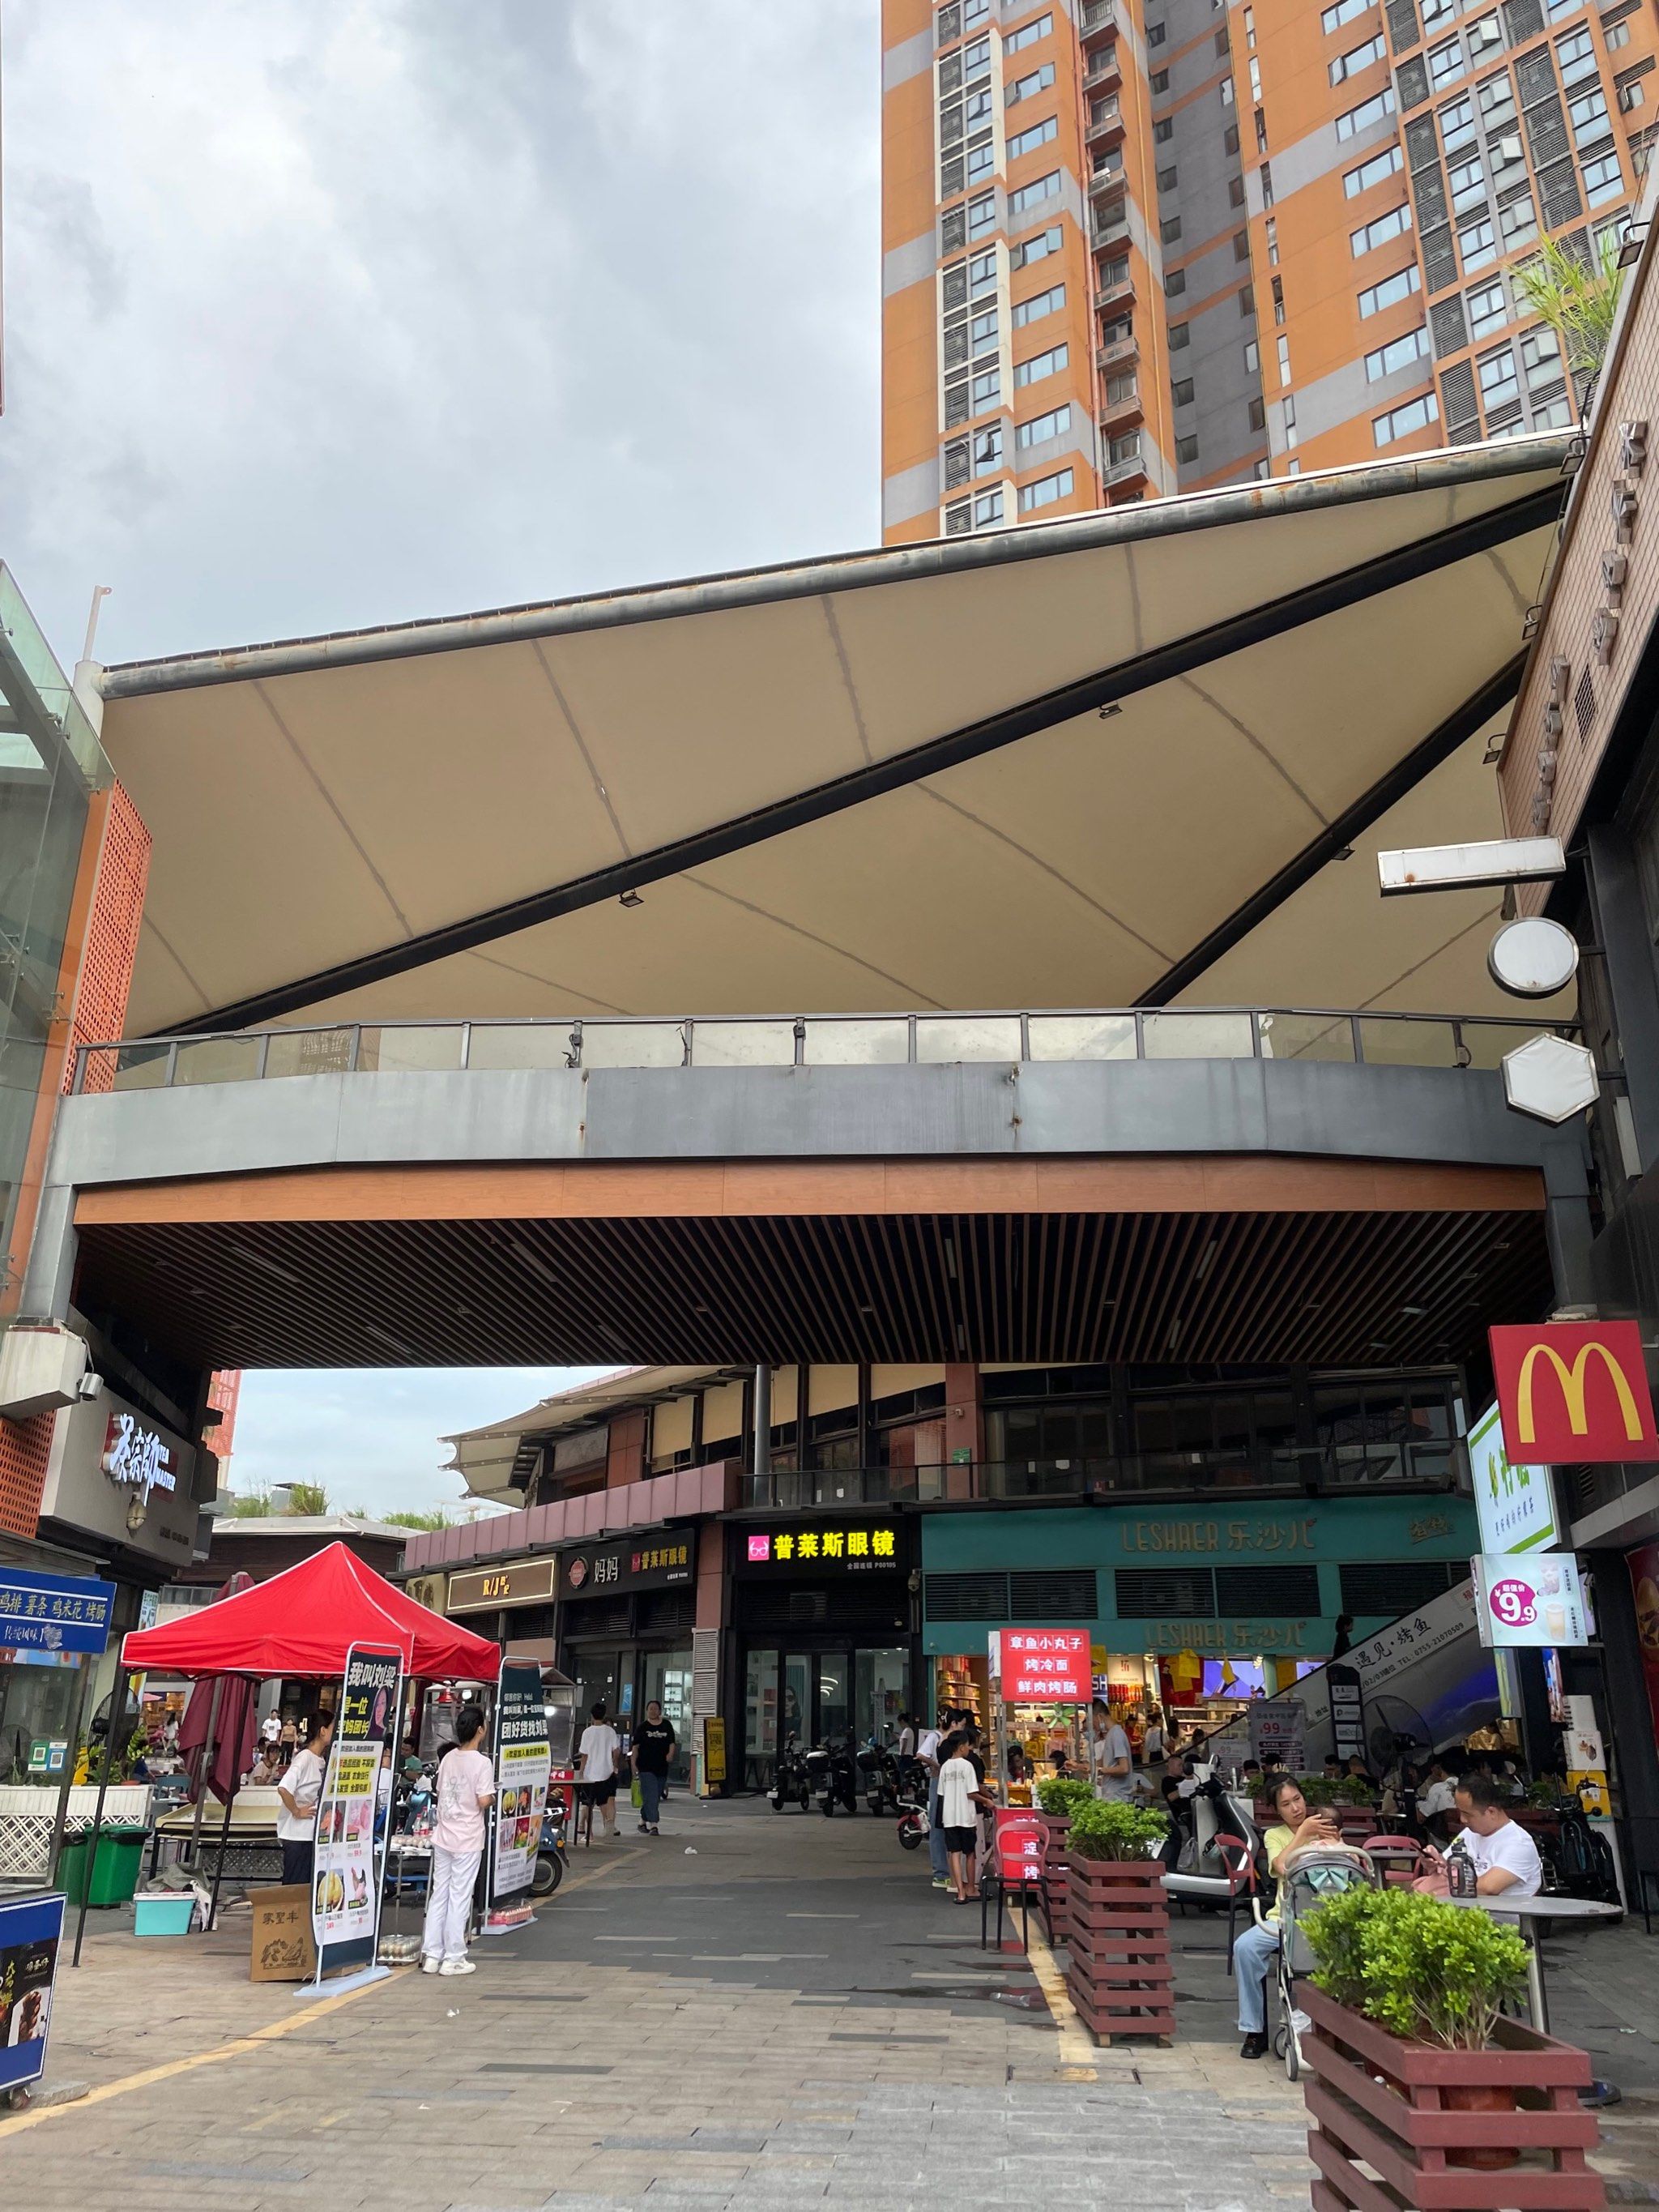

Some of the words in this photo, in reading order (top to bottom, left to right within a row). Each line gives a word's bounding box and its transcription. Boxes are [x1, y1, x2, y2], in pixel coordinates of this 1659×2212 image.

[642, 1545, 687, 1570] 普莱斯眼镜
[774, 1531, 895, 1560] 普莱斯眼镜
[594, 1557, 618, 1583] 妈妈
[25, 1595, 48, 1616] 薯条
[53, 1598, 83, 1619] 鸡米花
[86, 1602, 107, 1621] 烤肠
[1009, 1636, 1083, 1650] 章鱼小丸子
[1025, 1659, 1068, 1672] 烤冷面
[1017, 1680, 1077, 1694] 鲜肉烤肠
